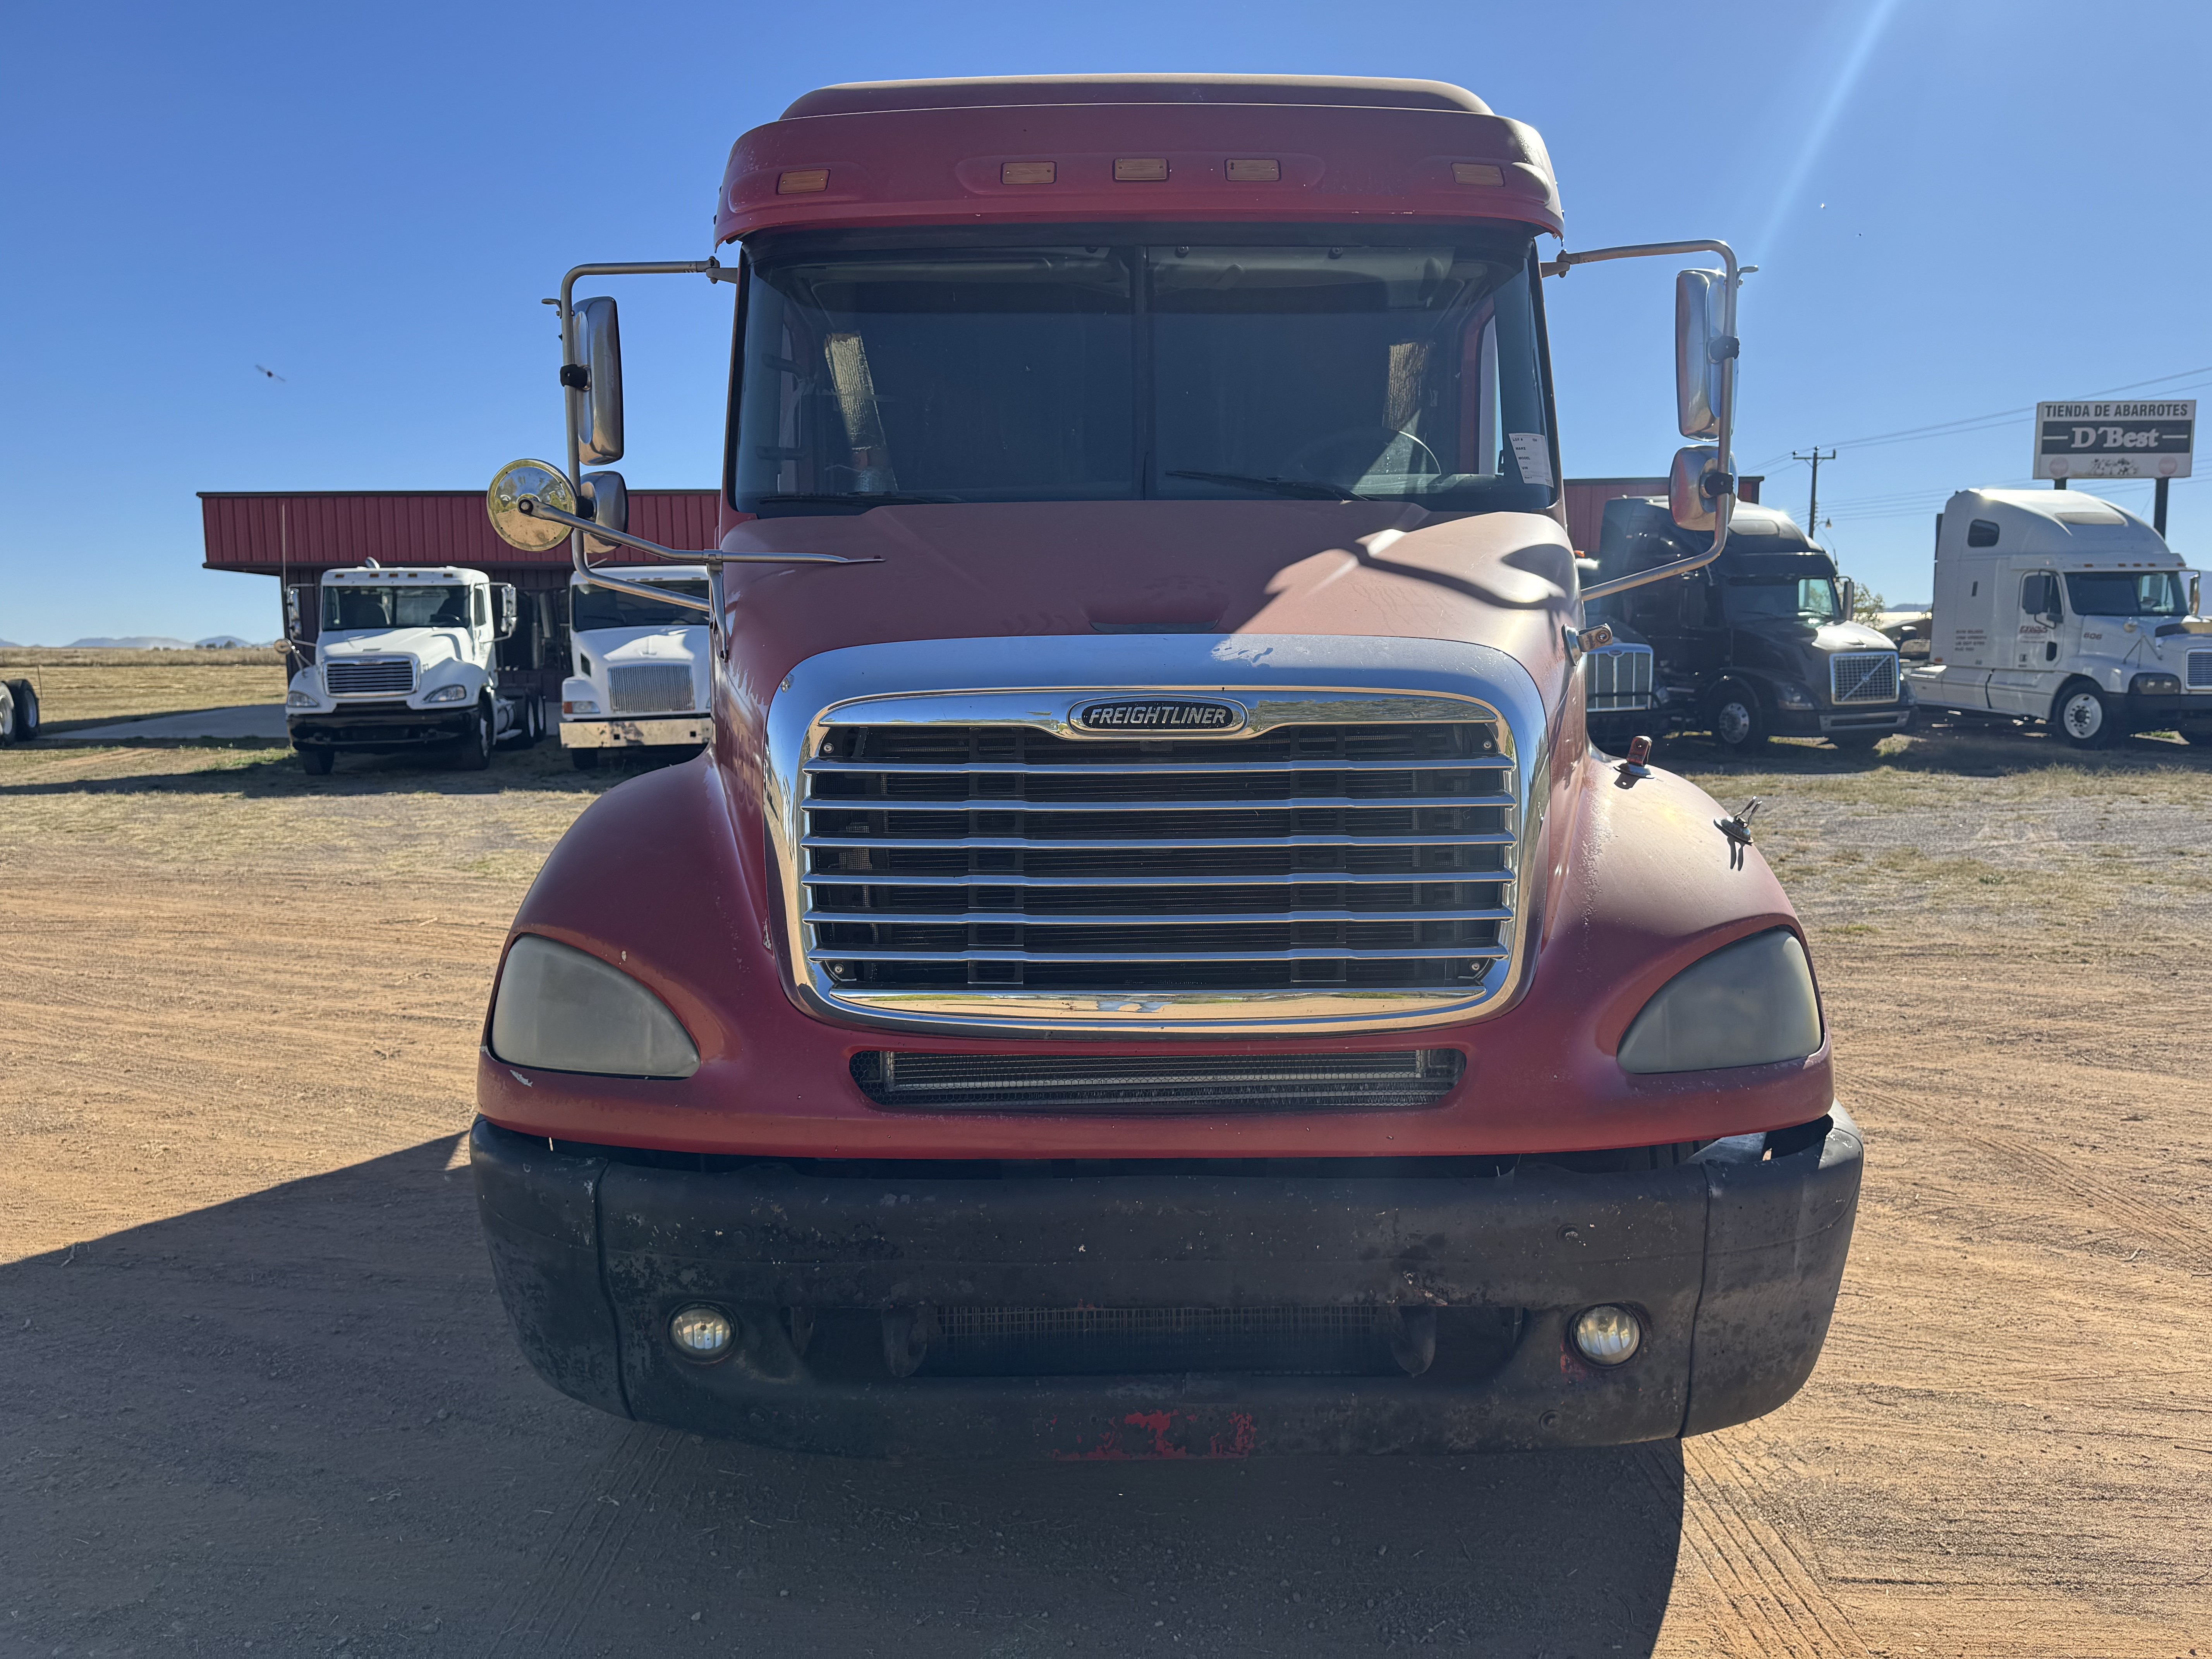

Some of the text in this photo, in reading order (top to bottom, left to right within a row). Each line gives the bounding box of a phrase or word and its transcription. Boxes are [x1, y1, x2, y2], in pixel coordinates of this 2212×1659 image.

[2045, 404, 2188, 417] TIENDA DE ABARROTES
[1089, 706, 1227, 724] FREIGHTLINER
